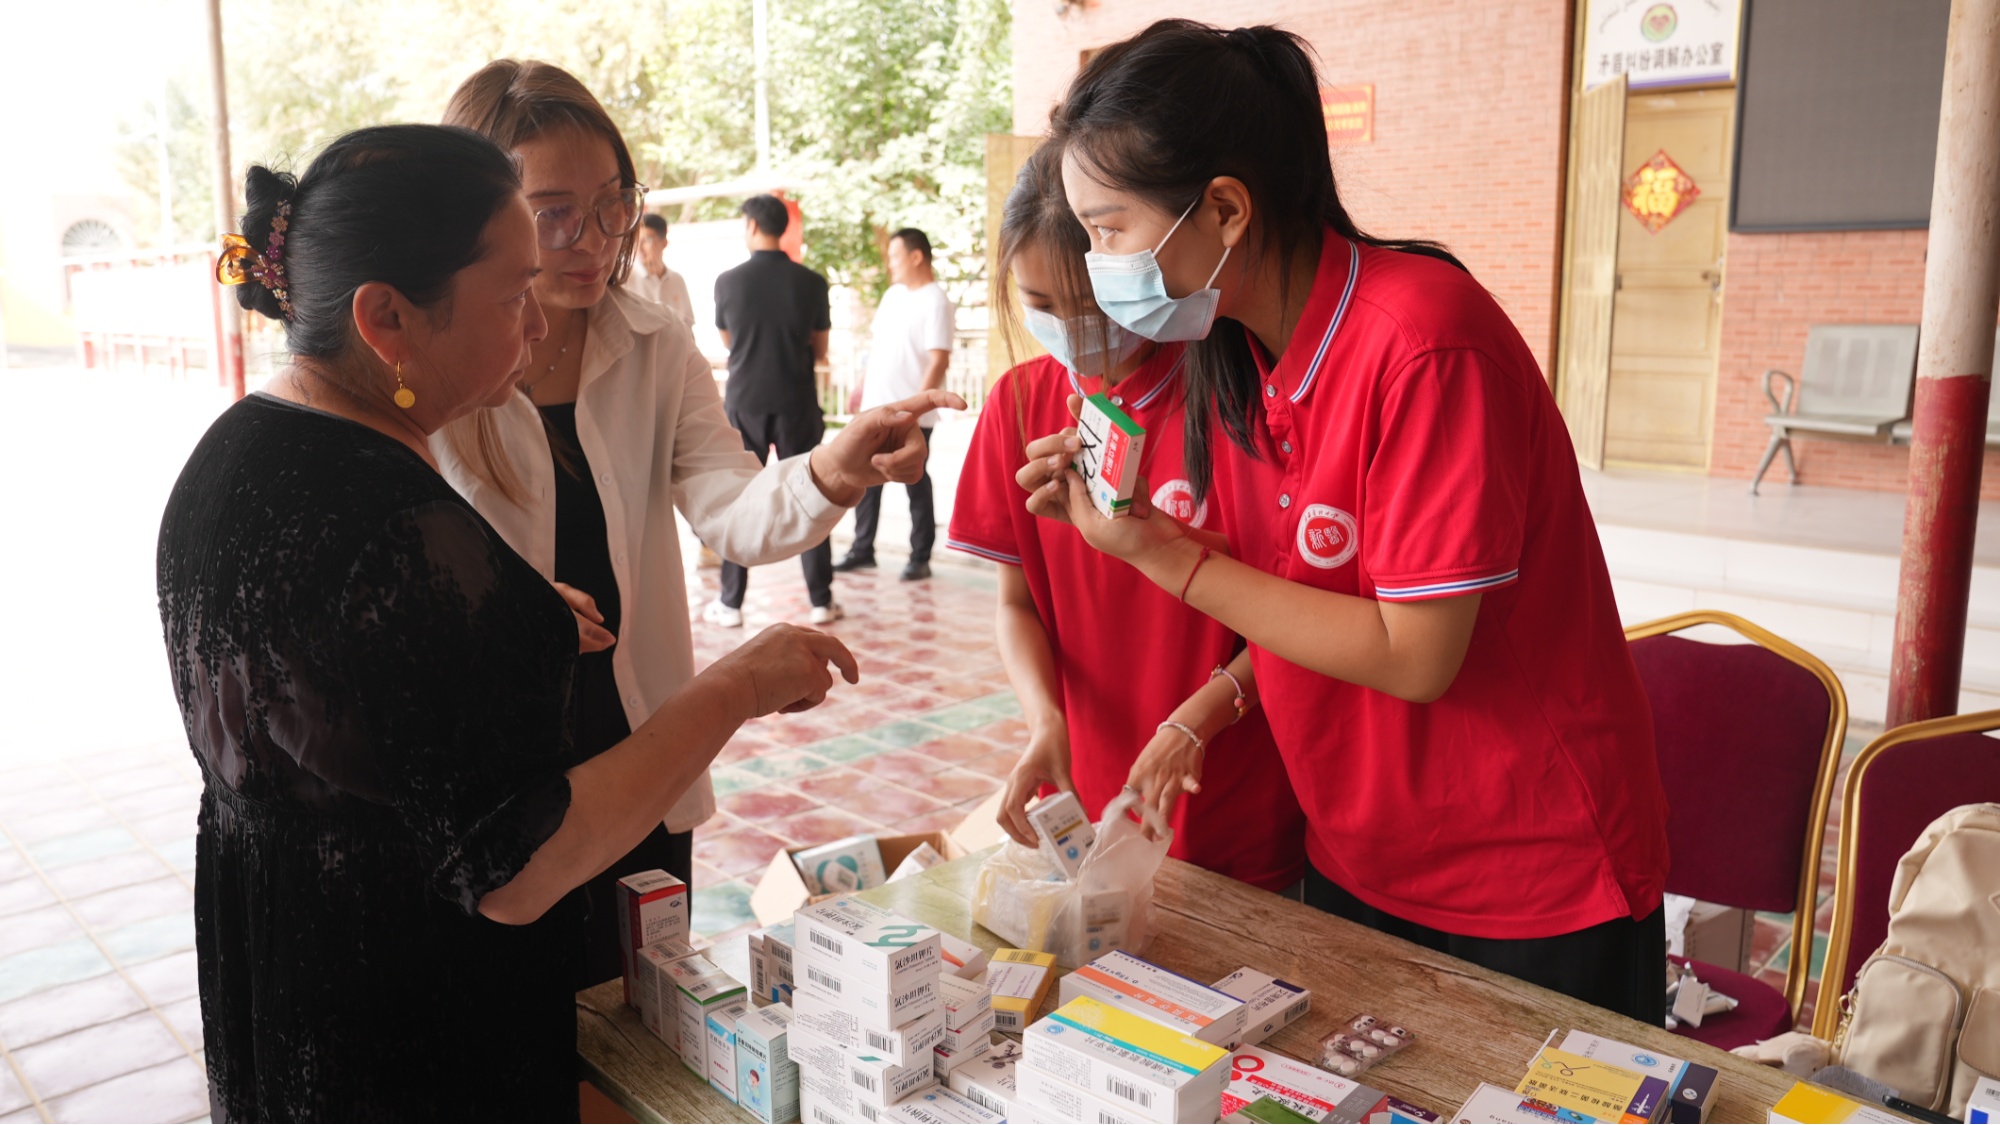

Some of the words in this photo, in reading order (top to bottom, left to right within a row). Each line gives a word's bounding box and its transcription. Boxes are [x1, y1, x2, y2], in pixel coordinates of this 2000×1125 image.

[1599, 42, 1724, 76] 矛盾纠纷调解办公室
[1632, 167, 1680, 219] 福
[895, 945, 934, 970] 氯沙坦钾片
[895, 982, 932, 1008] 氯沙坦钾片
[1527, 1078, 1623, 1111] 酪酸梭菌二联活菌散
